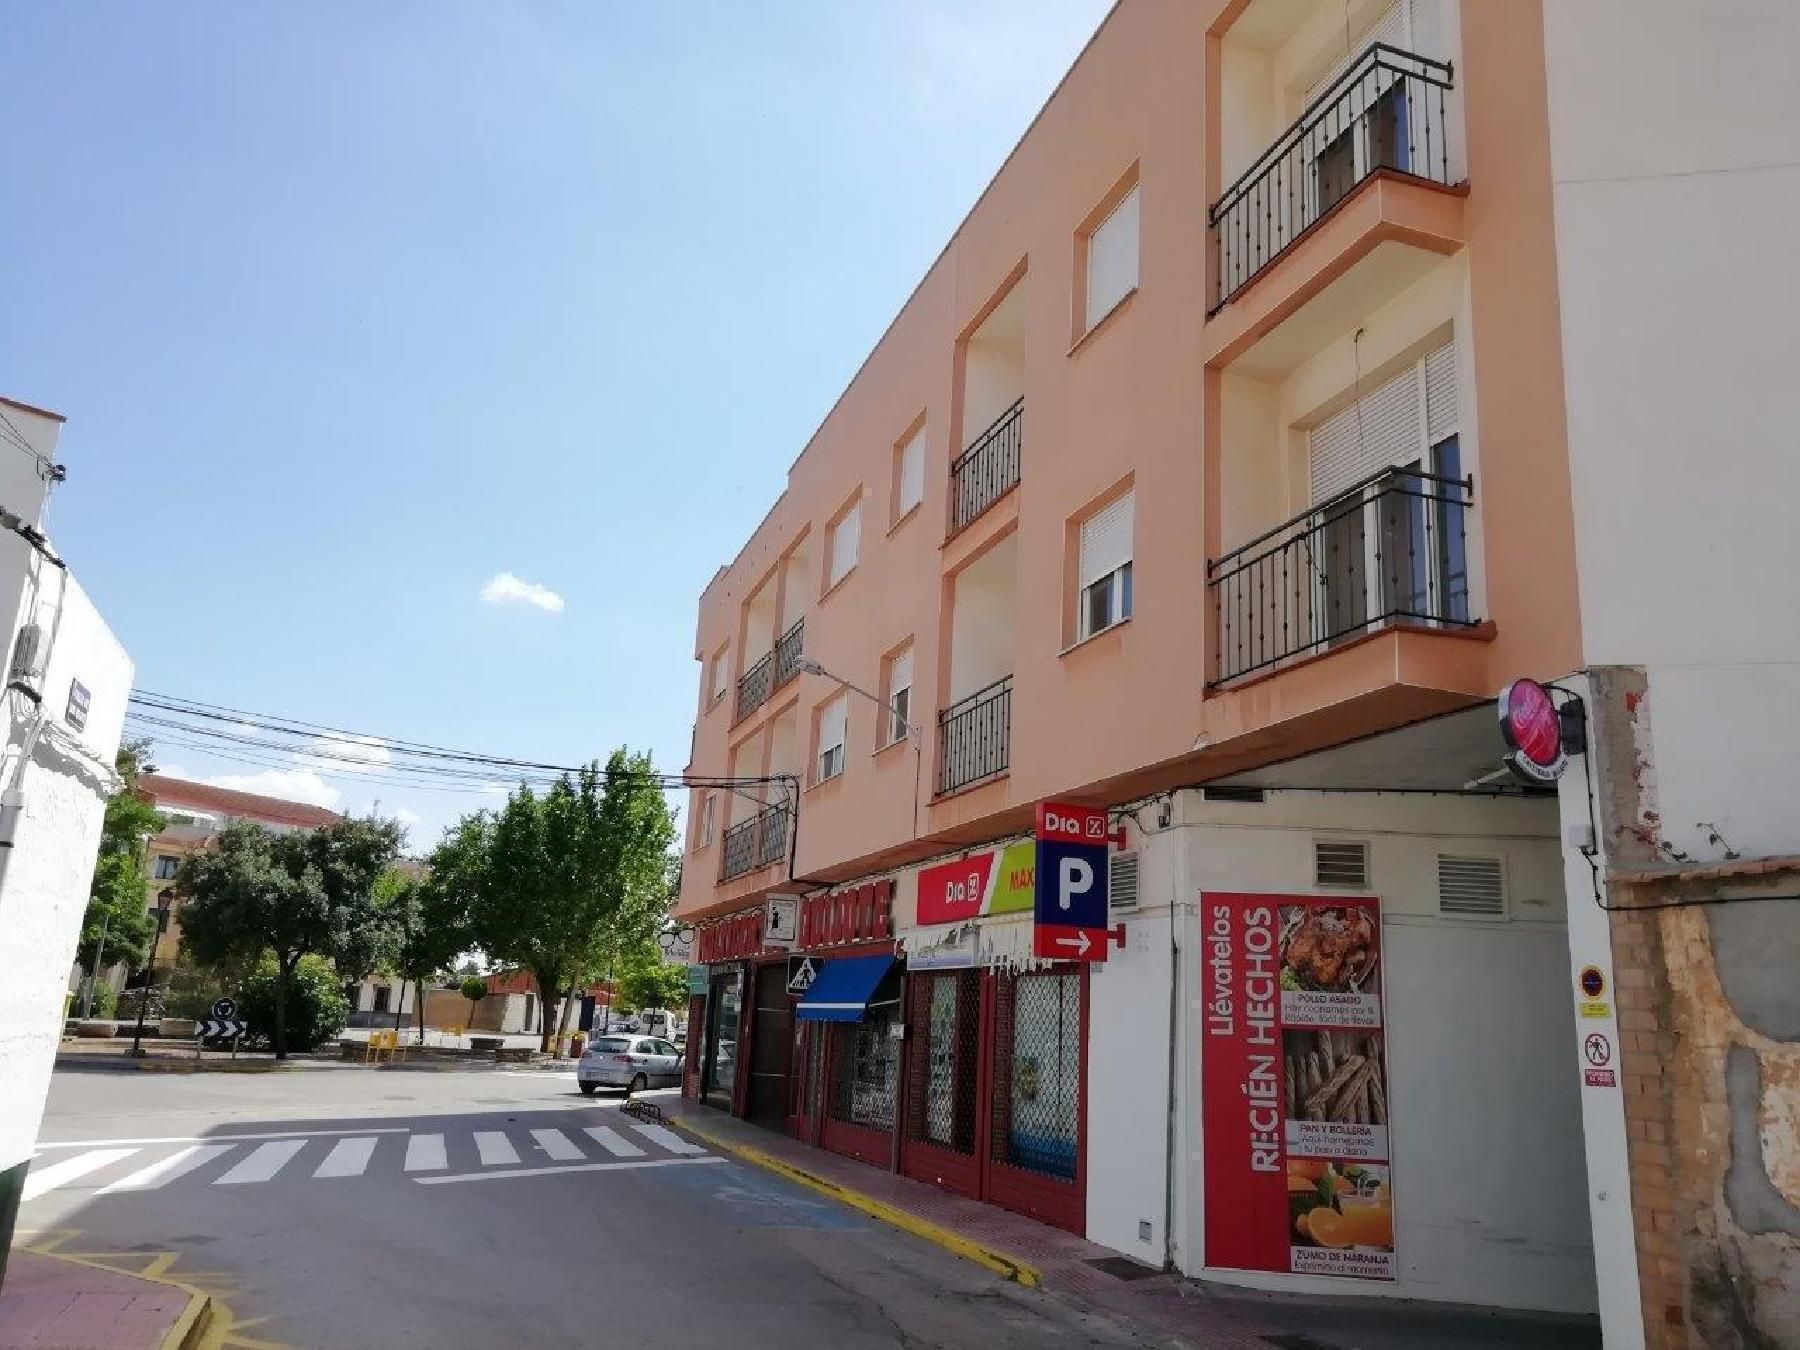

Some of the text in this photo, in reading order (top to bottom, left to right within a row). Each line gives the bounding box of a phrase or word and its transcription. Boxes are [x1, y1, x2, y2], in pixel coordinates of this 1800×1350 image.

[1059, 857, 1094, 911] P
[1207, 905, 1234, 1036] Llévatelos
[1297, 993, 1362, 1005] POLLO ASADO
[1240, 907, 1281, 1173] RECIÉN HECHOS
[1300, 1124, 1319, 1133] PAN
[1321, 1124, 1327, 1133] Y
[1296, 1249, 1389, 1265] ZUMO DE NARANJA
